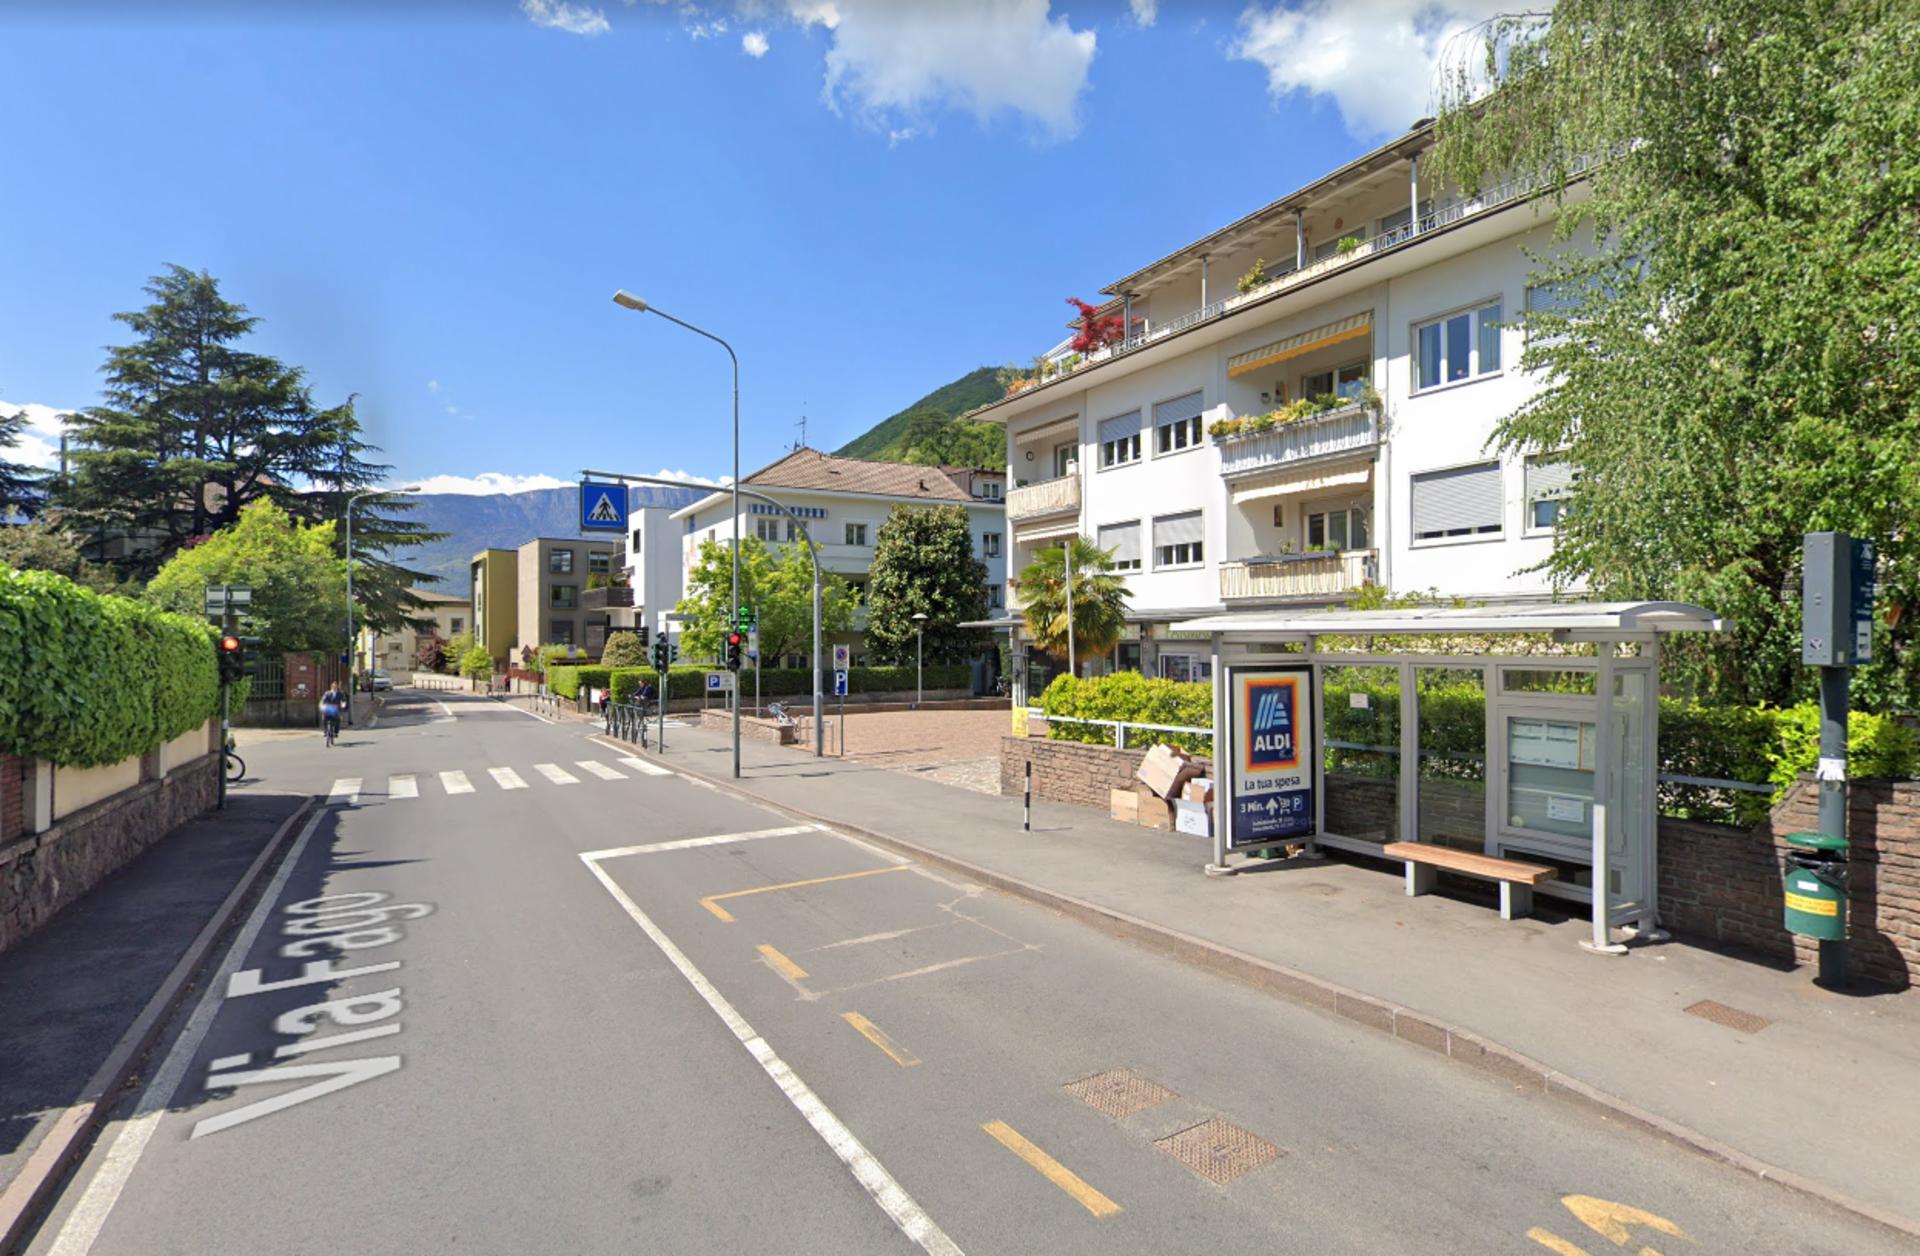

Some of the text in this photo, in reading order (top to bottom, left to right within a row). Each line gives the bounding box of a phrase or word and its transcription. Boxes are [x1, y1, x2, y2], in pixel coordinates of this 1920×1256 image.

[1254, 733, 1291, 751] ALDI
[1245, 776, 1300, 790] La tua spesa
[1240, 803, 1246, 813] 3
